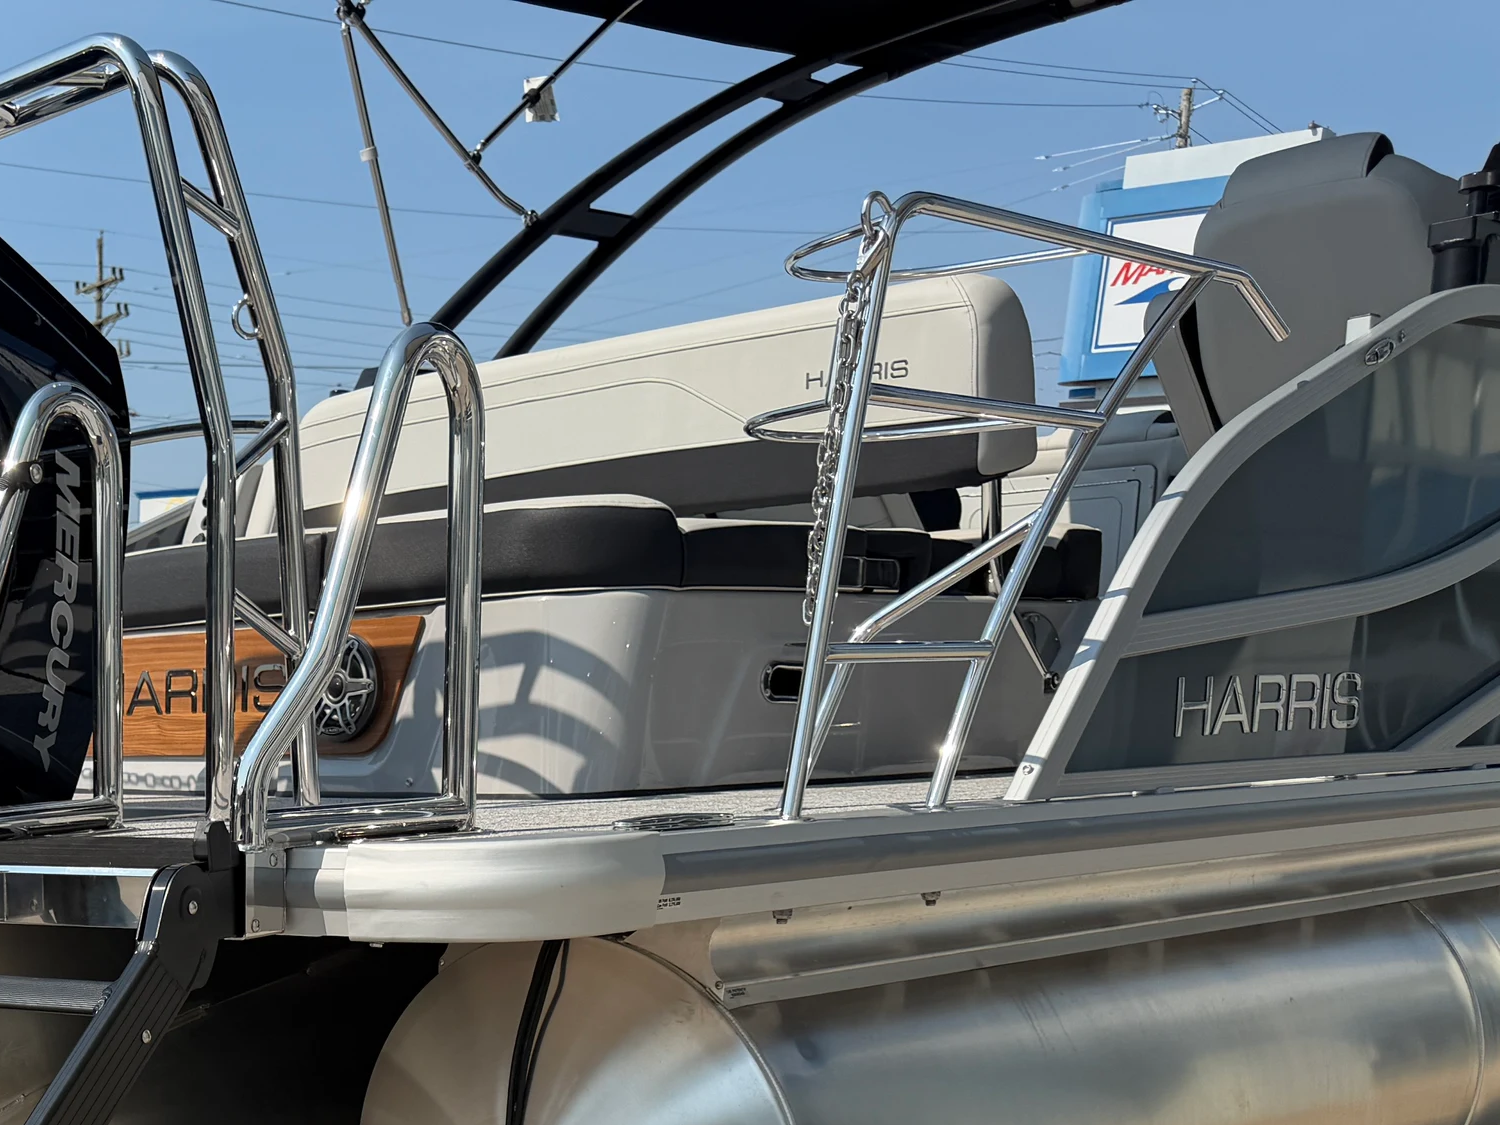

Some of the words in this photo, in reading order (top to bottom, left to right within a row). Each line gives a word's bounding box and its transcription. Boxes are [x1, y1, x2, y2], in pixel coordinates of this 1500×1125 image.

[33, 450, 81, 772] MERCURY
[123, 663, 289, 716] ARIS
[1175, 671, 1362, 738] HARRIS
